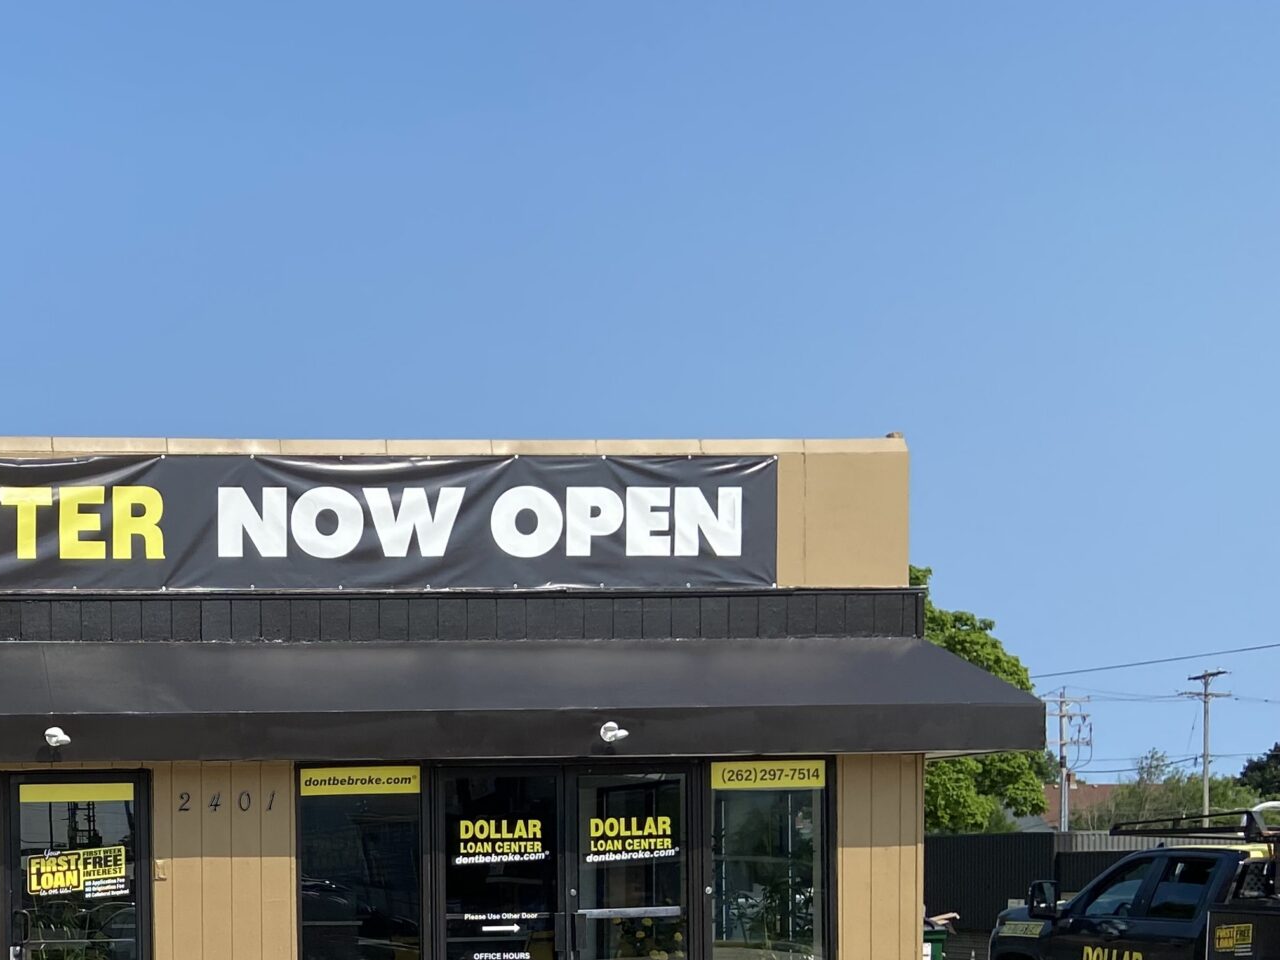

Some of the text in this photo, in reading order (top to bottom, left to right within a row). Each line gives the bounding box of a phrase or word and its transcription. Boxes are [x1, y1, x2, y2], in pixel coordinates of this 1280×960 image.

[217, 485, 467, 559] NOW
[490, 484, 743, 559] OPEN
[459, 819, 542, 839] DOLLAR
[589, 816, 672, 837] DOLLAR
[82, 847, 122, 857] FIRST WEEK
[460, 841, 542, 853] LOAN CENTER
[590, 838, 672, 851] LOAN CENTER
[31, 854, 78, 874] FIRST
[82, 854, 123, 870] FREE
[31, 870, 78, 891] LOAN
[82, 867, 123, 878] INTEREST
[473, 952, 531, 960] OFFICE HOURS
